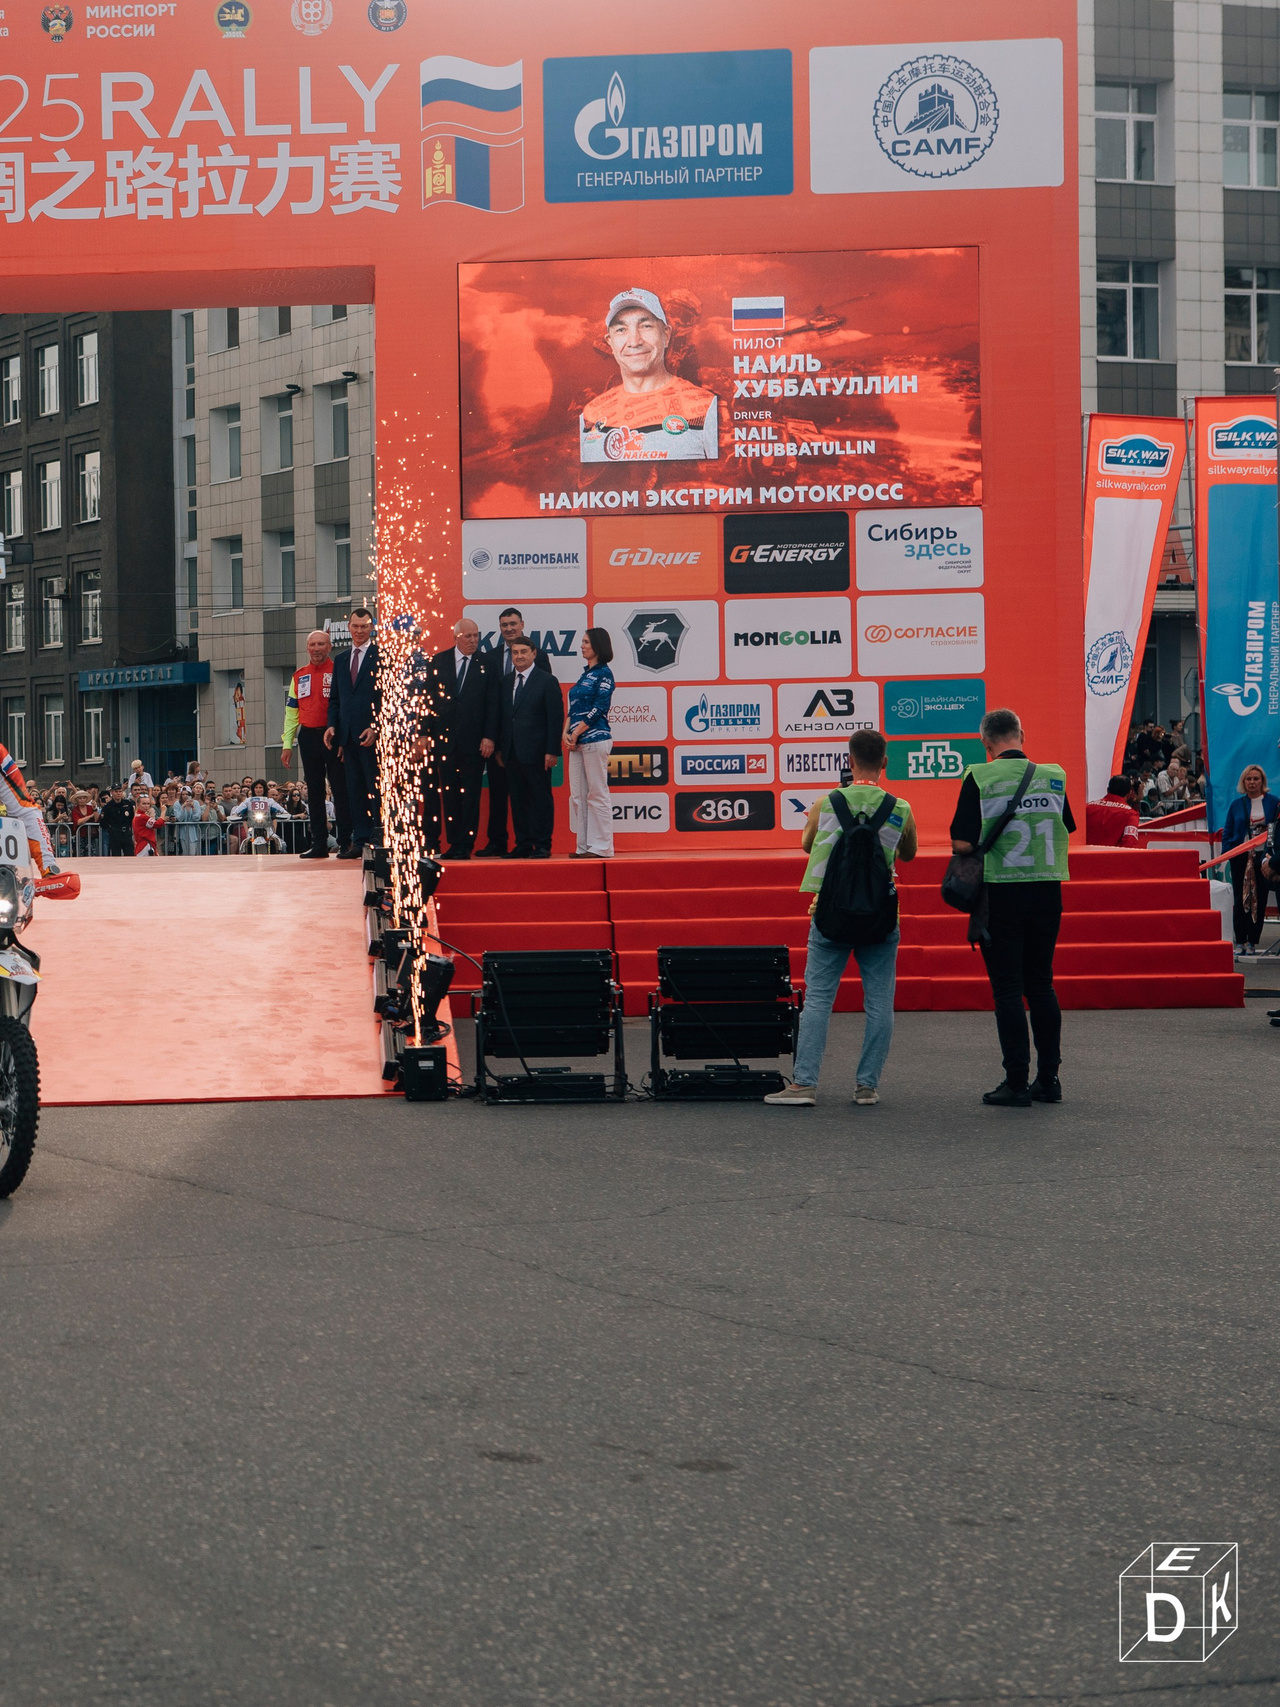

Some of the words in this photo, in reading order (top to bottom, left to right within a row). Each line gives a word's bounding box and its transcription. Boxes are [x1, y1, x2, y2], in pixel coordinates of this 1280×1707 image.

[86, 3, 177, 19] МИНСПОРТ
[86, 22, 156, 39] РОССИИ
[100, 64, 401, 140] RALLY
[631, 122, 763, 160] ГАЗПРОМ
[891, 137, 981, 157] CAMF
[577, 166, 690, 187] ГЕНЕРАЛЬНЫЙ
[695, 166, 763, 183] ПАРТНЕР
[733, 337, 784, 351] ПИЛОТ
[733, 353, 822, 375] НАИЛЬ
[733, 376, 918, 399] ХУББАТУЛЛИН
[733, 410, 772, 421] DRIVER
[734, 426, 778, 441] NAIL
[1217, 432, 1254, 442] SILK
[1255, 432, 1278, 442] WA
[734, 440, 876, 457] KHUBBATULLIN
[1107, 448, 1141, 460] SILK
[1141, 451, 1169, 461] WAY
[1208, 465, 1278, 476] silkwayrally.c
[1096, 479, 1167, 492] silkwayrally.com
[539, 491, 639, 511] НАИКОМ
[646, 487, 754, 507] ЭКСТРИМ
[759, 483, 904, 505] МОТОКРОСС
[868, 523, 958, 544] Сибирь
[498, 552, 579, 565] ГАЗПРОМБАНК
[904, 542, 971, 560] здесь
[1271, 601, 1280, 646] ПАРТНЕР
[734, 630, 842, 646] MONGOLIA
[895, 626, 978, 639] СОГЛАСИЕ
[479, 630, 577, 656] KAZ
[1244, 601, 1266, 682] ГАЗПРОМ
[88, 667, 173, 685] ИРКУТСКСТАТ
[1268, 647, 1279, 715] ГЕНЕРАЛЬНЫЙ
[924, 695, 979, 704] БАЙКАЛЬСК
[924, 703, 965, 711] ЭКО.ЦЕХ
[608, 705, 650, 714] УССКАЯ
[710, 703, 761, 718] ГАЗПРОМ
[608, 714, 658, 724] ЕХАНИКА
[711, 718, 761, 727] ДОБЫЧА
[785, 721, 874, 732] ЛЕНЗОЛОТО
[608, 754, 662, 778] АТЧ!
[686, 758, 740, 771] РОССИЯ
[748, 758, 765, 770] 24
[786, 752, 850, 773] ИЗВЕСТИЯ
[908, 741, 963, 778] НТВ
[255, 802, 265, 810] 30
[701, 799, 750, 820] 360
[1007, 798, 1049, 809] POTO
[612, 805, 662, 820] 2ГИС
[1002, 819, 1056, 867] 21
[35, 882, 65, 893] CERBIS
